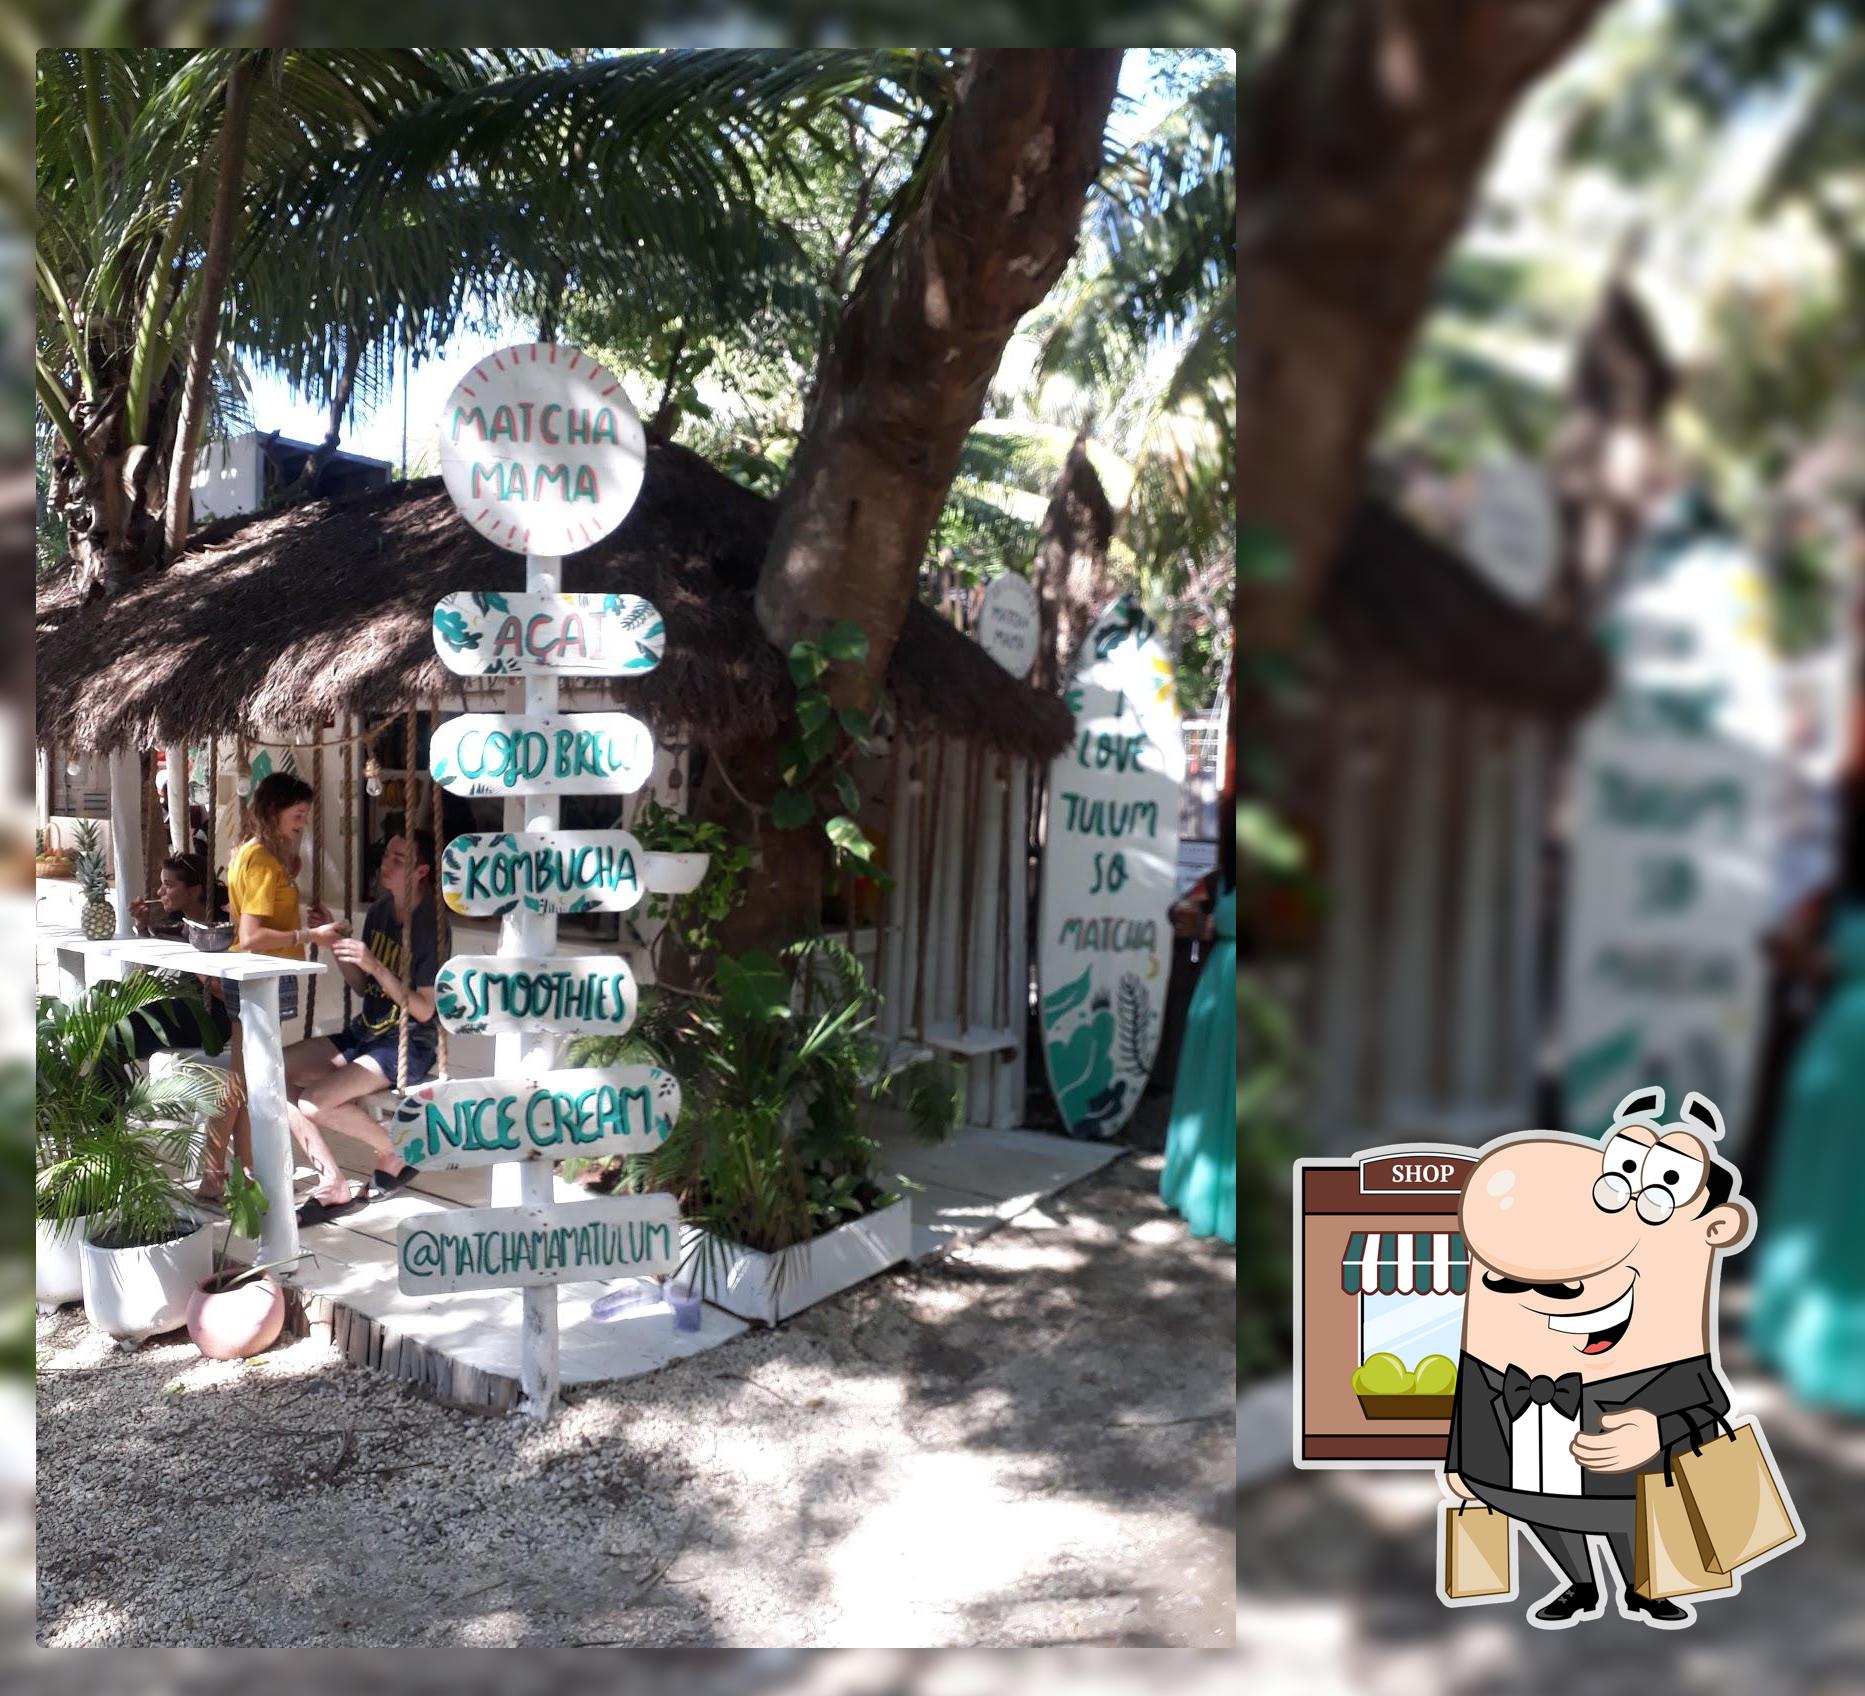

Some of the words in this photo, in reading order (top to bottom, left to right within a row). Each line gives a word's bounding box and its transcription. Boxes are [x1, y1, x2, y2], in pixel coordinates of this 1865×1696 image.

[452, 402, 620, 446] MATCHA
[471, 461, 602, 503] MAMA
[493, 612, 608, 666] AÇAI
[457, 729, 549, 788] COLD
[1077, 730, 1147, 774] LOVE
[1060, 791, 1158, 838] TULUM
[465, 845, 639, 900] KOMBUCHA
[1089, 852, 1127, 894] SO
[1058, 916, 1157, 952] MATCHA
[463, 967, 626, 1024] SMOOTHIES
[424, 1096, 519, 1156] NICE
[525, 1083, 654, 1149] CREAM
[402, 1222, 672, 1278] @MATCHAMAMATULUM
